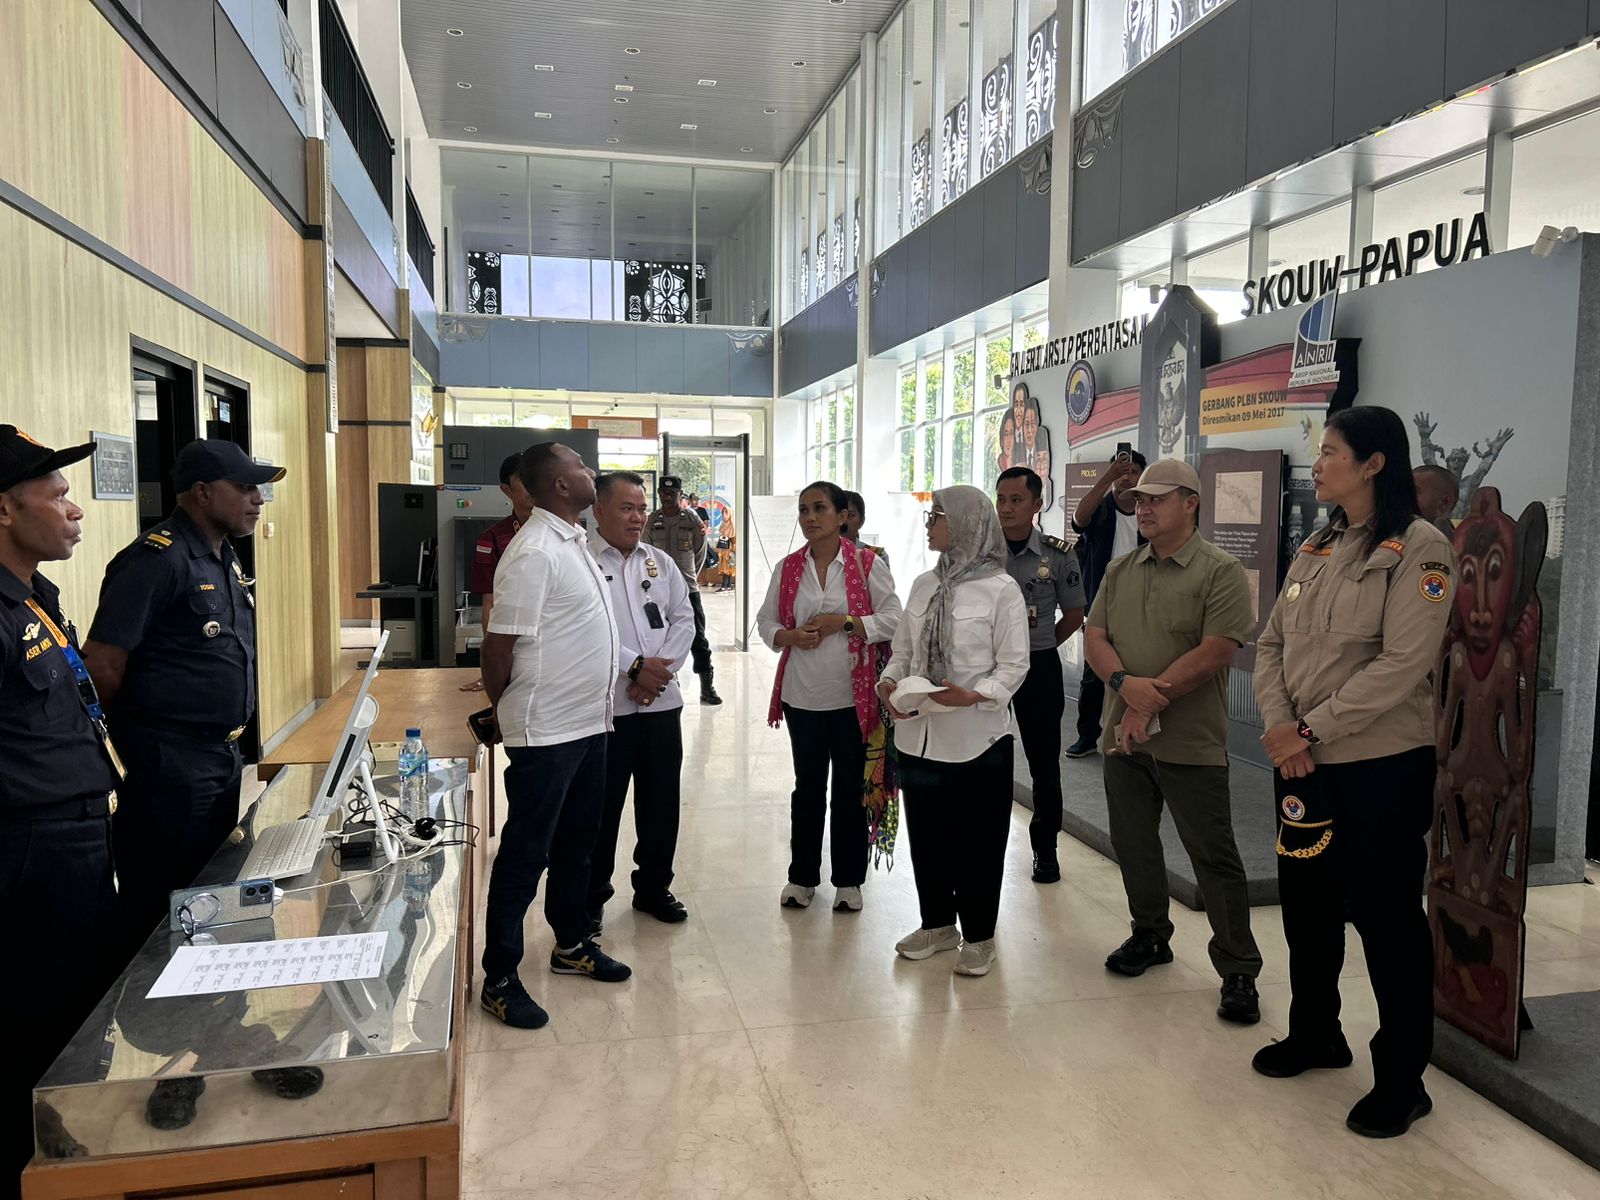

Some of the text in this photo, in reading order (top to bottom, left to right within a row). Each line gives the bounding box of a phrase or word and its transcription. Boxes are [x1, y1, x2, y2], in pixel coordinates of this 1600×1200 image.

[1042, 335, 1074, 369] ARSIP
[1295, 345, 1334, 366] ANRI
[1294, 367, 1333, 379] ARSIP NASIONAL
[1312, 374, 1338, 383] INDONESIA
[1202, 389, 1287, 412] GERBANG PLBN SKOUW
[1202, 407, 1286, 426] Diresmikan 09 Mei 2017
[1081, 469, 1097, 478] PROLOG
